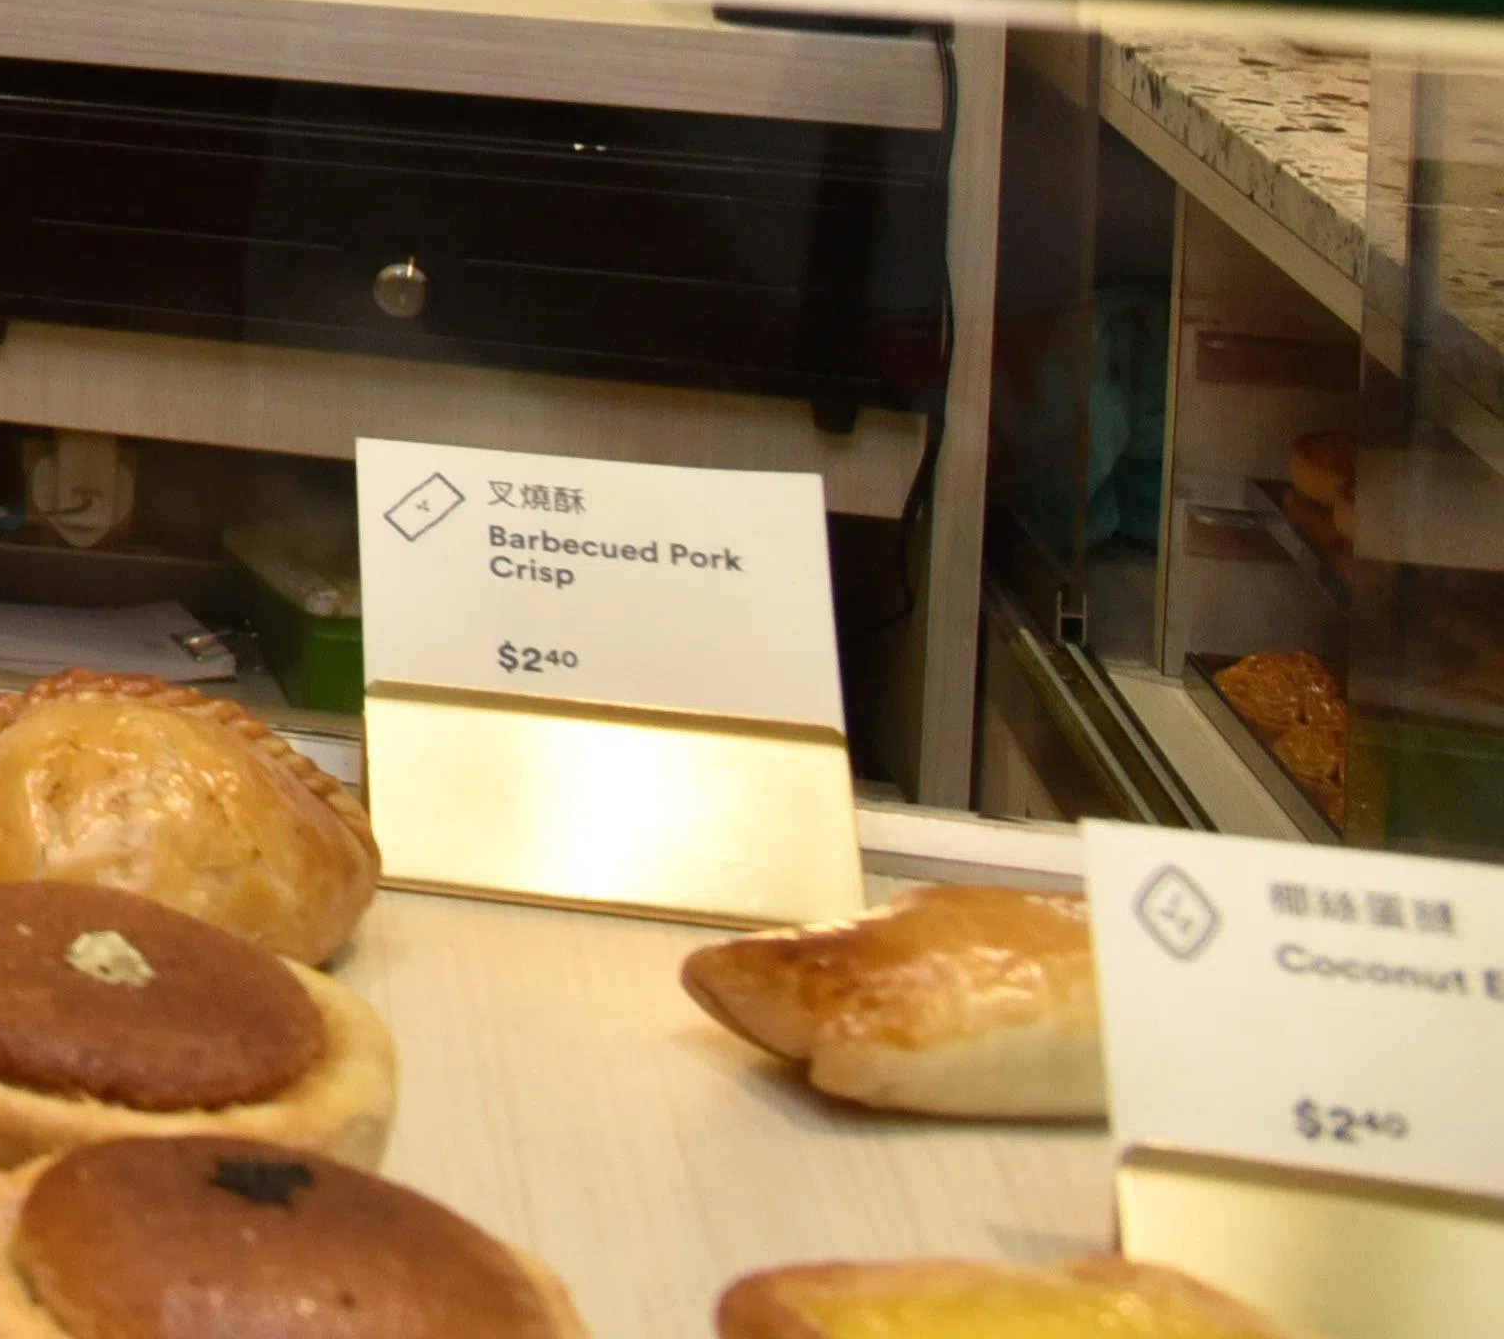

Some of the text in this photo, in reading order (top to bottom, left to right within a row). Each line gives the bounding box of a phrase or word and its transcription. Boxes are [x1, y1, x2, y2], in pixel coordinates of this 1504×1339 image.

[487, 480, 586, 516] 叉燒酥
[488, 524, 743, 572] Barbecued Pork
[489, 555, 575, 590] Crisp
[1275, 943, 1468, 994] Coconut
